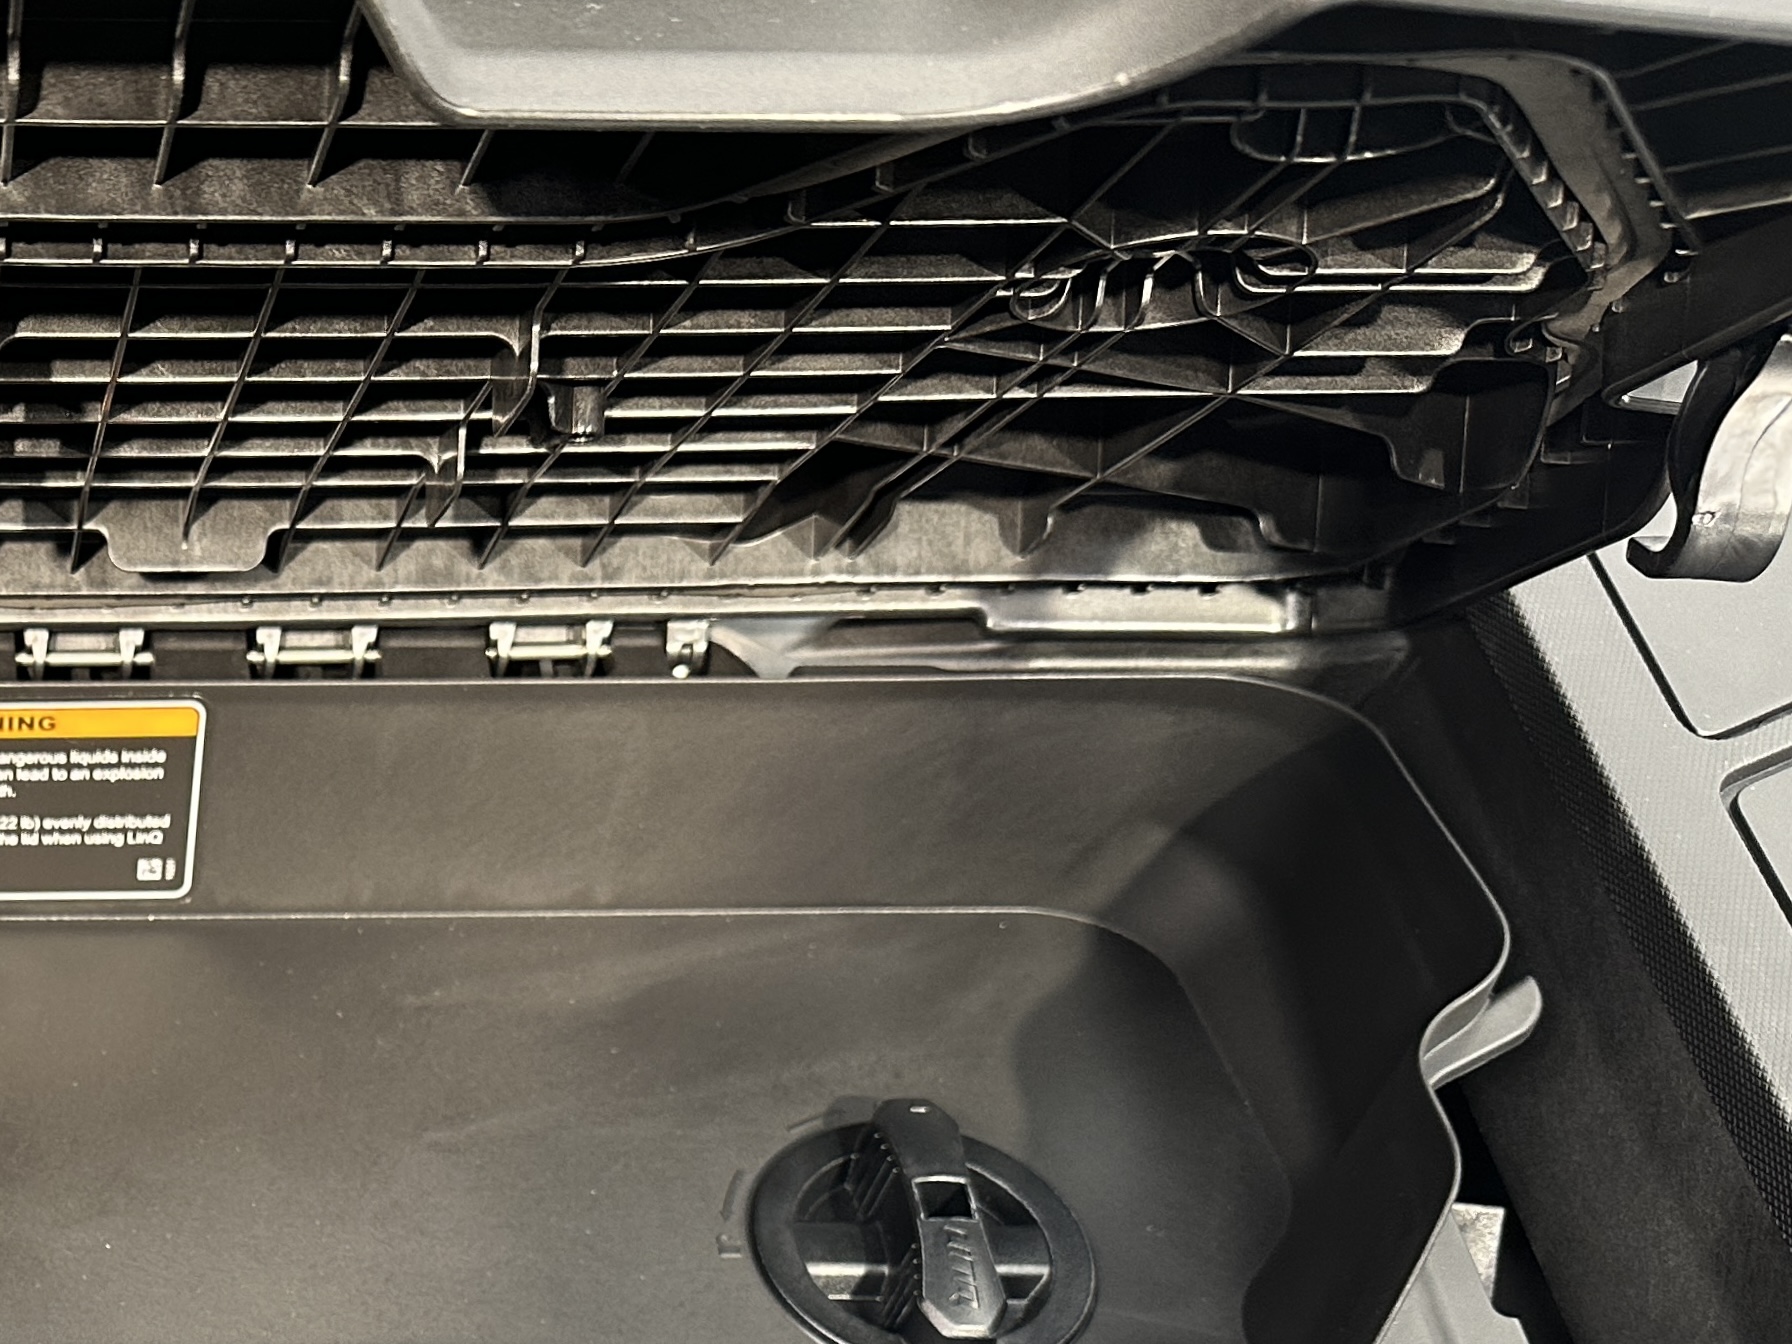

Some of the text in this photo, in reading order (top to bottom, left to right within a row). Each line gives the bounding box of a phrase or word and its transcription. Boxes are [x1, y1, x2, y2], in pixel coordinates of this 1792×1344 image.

[69, 749, 119, 766] liquids
[121, 748, 167, 764] inside
[16, 767, 50, 781] lead
[51, 767, 68, 781] to
[69, 768, 91, 781] an
[92, 766, 165, 782] explosion
[20, 815, 41, 831] lb)
[42, 814, 92, 831] evenly
[93, 813, 172, 829] distributed
[20, 832, 40, 846] lid
[41, 831, 82, 845] when
[84, 831, 125, 847] using
[126, 830, 164, 845] LinQ
